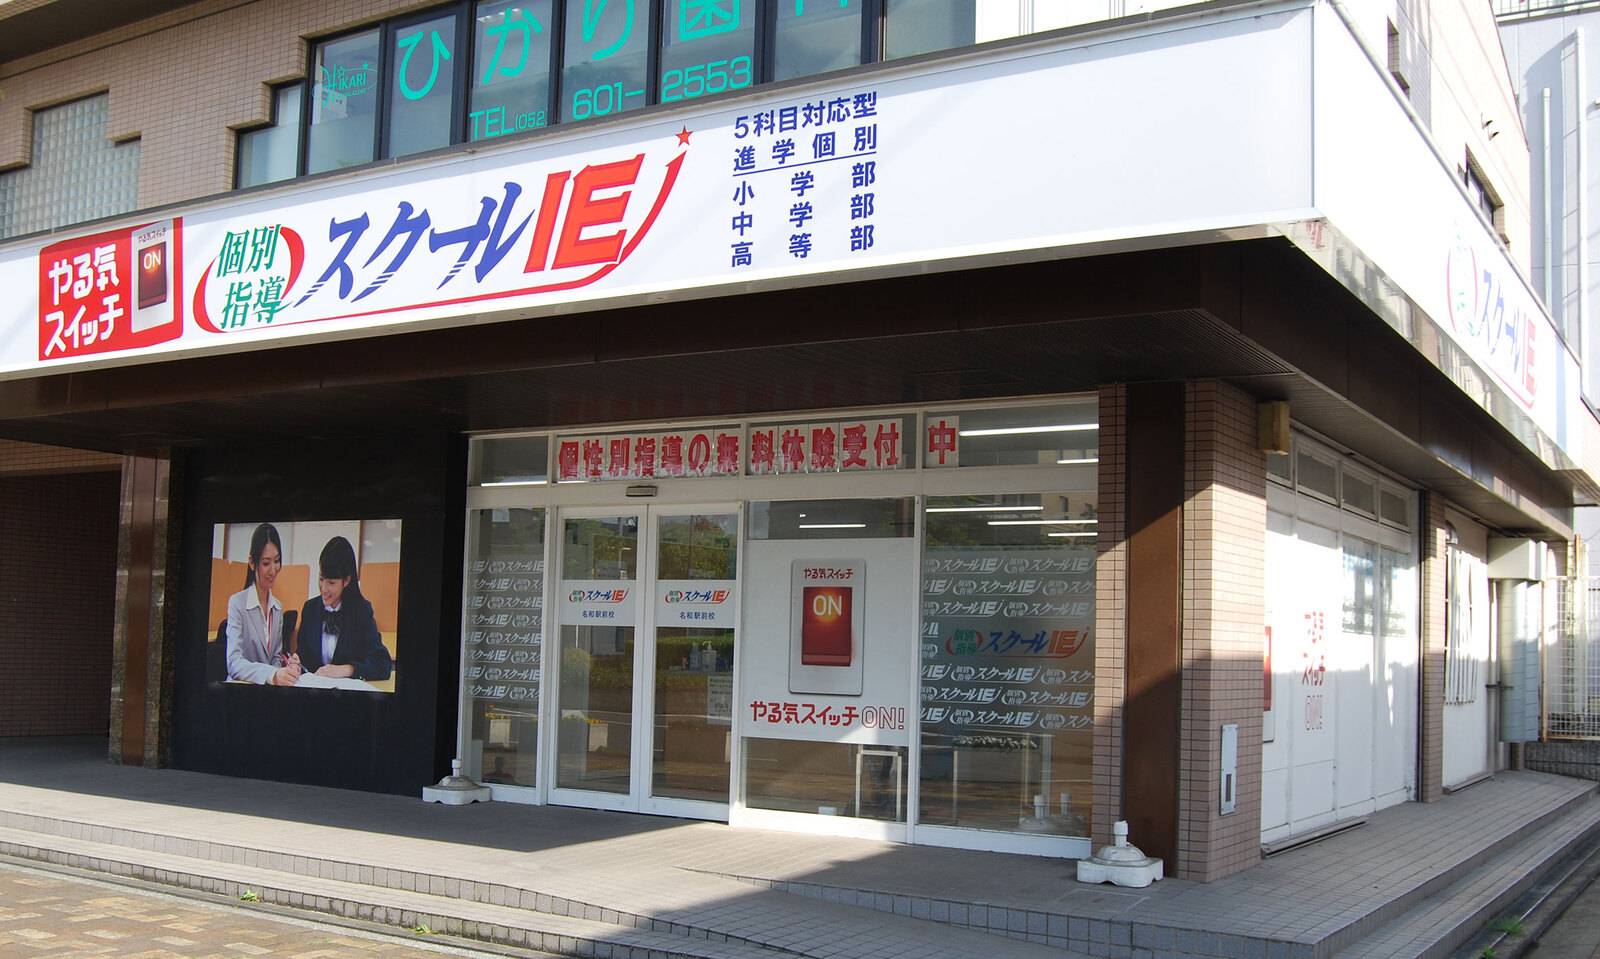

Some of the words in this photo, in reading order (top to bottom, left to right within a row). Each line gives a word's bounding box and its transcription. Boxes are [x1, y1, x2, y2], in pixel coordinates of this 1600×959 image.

[398, 0, 848, 101] ひかり
[734, 92, 877, 139] 5科目対応型
[733, 124, 877, 171] 進学個別
[216, 223, 281, 278] 個別
[293, 153, 646, 307] スクールIE
[48, 243, 120, 306] やる気
[143, 249, 162, 270] ON
[44, 293, 124, 357] スイッチ
[221, 275, 289, 329] 指導
[803, 567, 853, 580] やる気スイッチ
[813, 595, 842, 617] ON
[983, 629, 1081, 654] スクールIE
